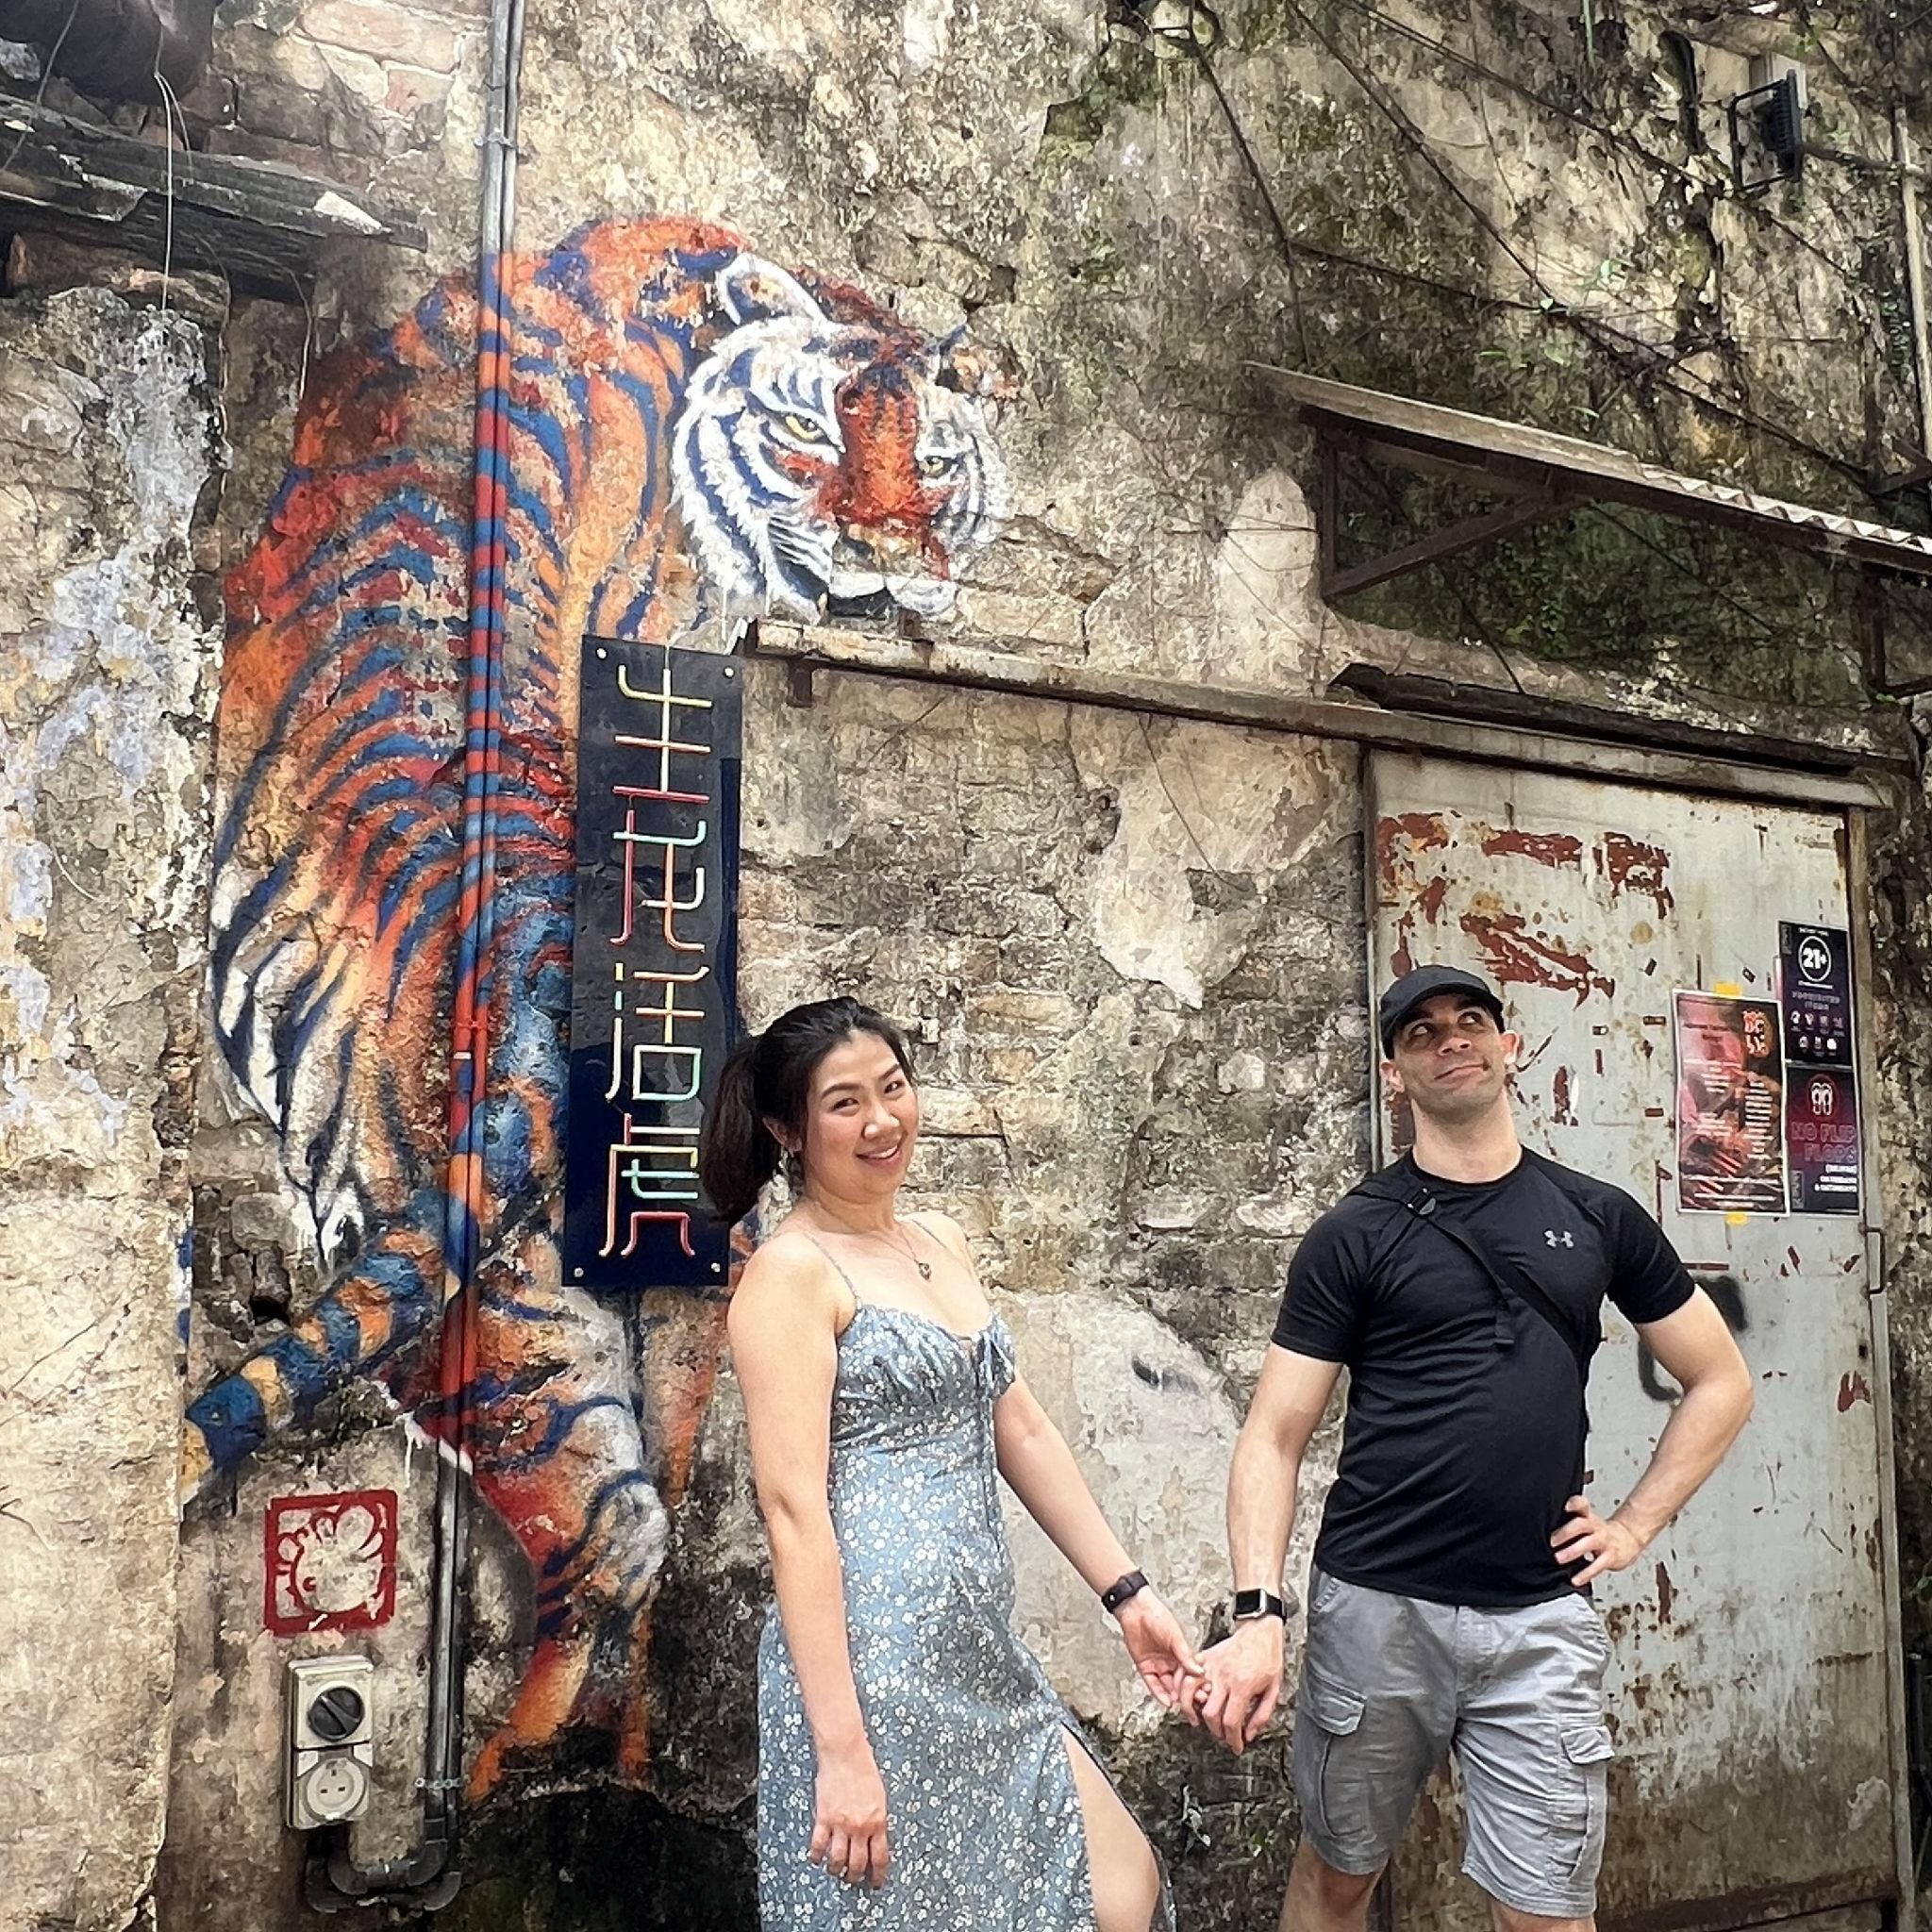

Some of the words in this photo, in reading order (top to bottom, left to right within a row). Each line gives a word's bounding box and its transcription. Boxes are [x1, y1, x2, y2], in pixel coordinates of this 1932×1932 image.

[1803, 947, 1828, 969] 21+
[1791, 1122, 1818, 1141] NO
[1820, 1123, 1857, 1143] FLIP
[1805, 1143, 1857, 1163] FLOPS
